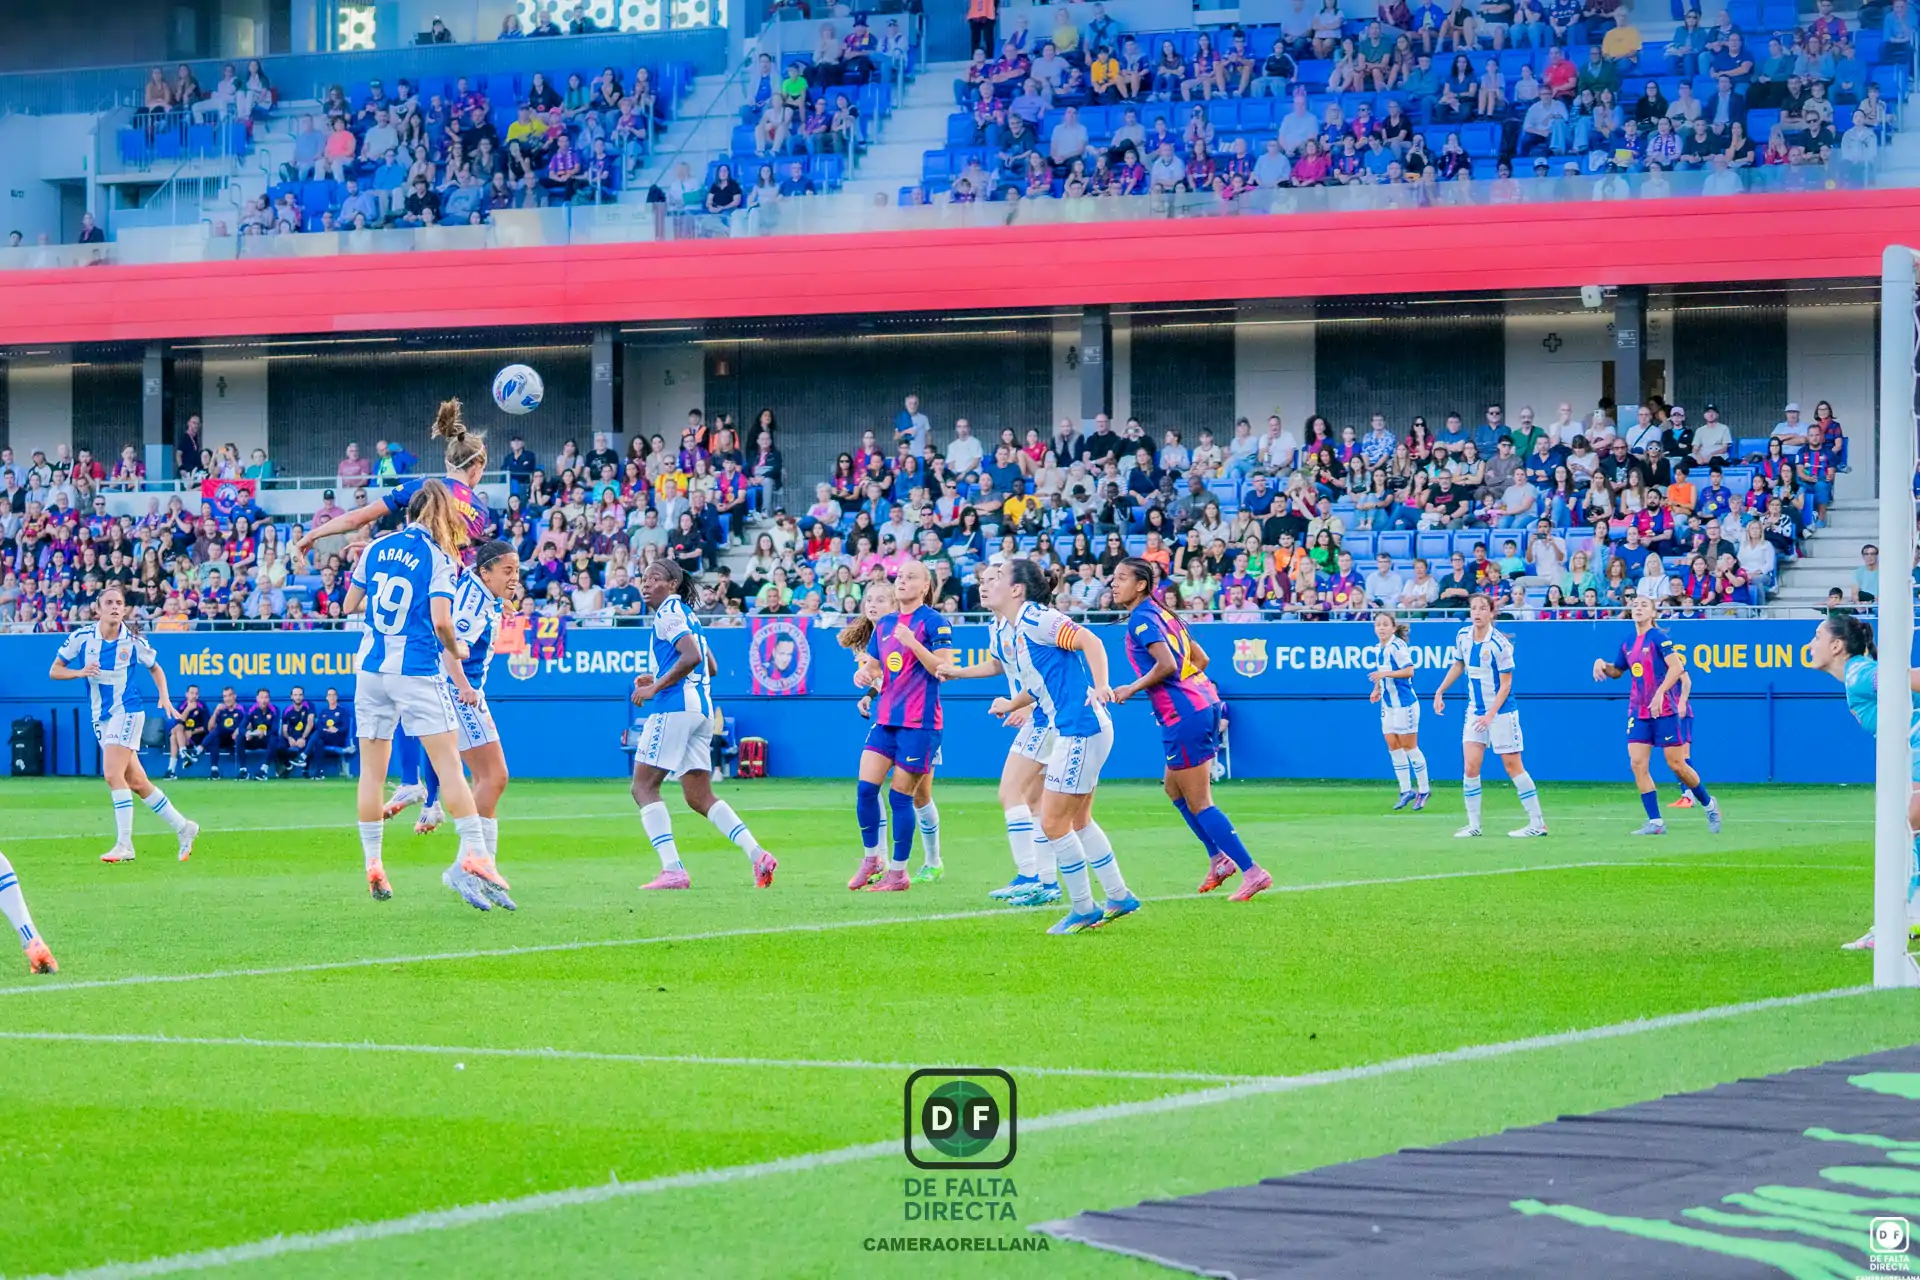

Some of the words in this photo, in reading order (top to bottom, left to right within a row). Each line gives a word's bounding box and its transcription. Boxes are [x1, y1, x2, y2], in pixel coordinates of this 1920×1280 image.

[378, 548, 420, 571] ARANA
[371, 571, 414, 635] 19
[536, 617, 560, 639] 22
[179, 647, 224, 675] MÉS
[228, 653, 271, 680] QUE
[276, 653, 306, 675] UN
[1275, 646, 1305, 670] FC
[1310, 646, 1458, 670] BARCONA
[1693, 644, 1748, 674] QUE
[1755, 644, 1793, 668] UN
